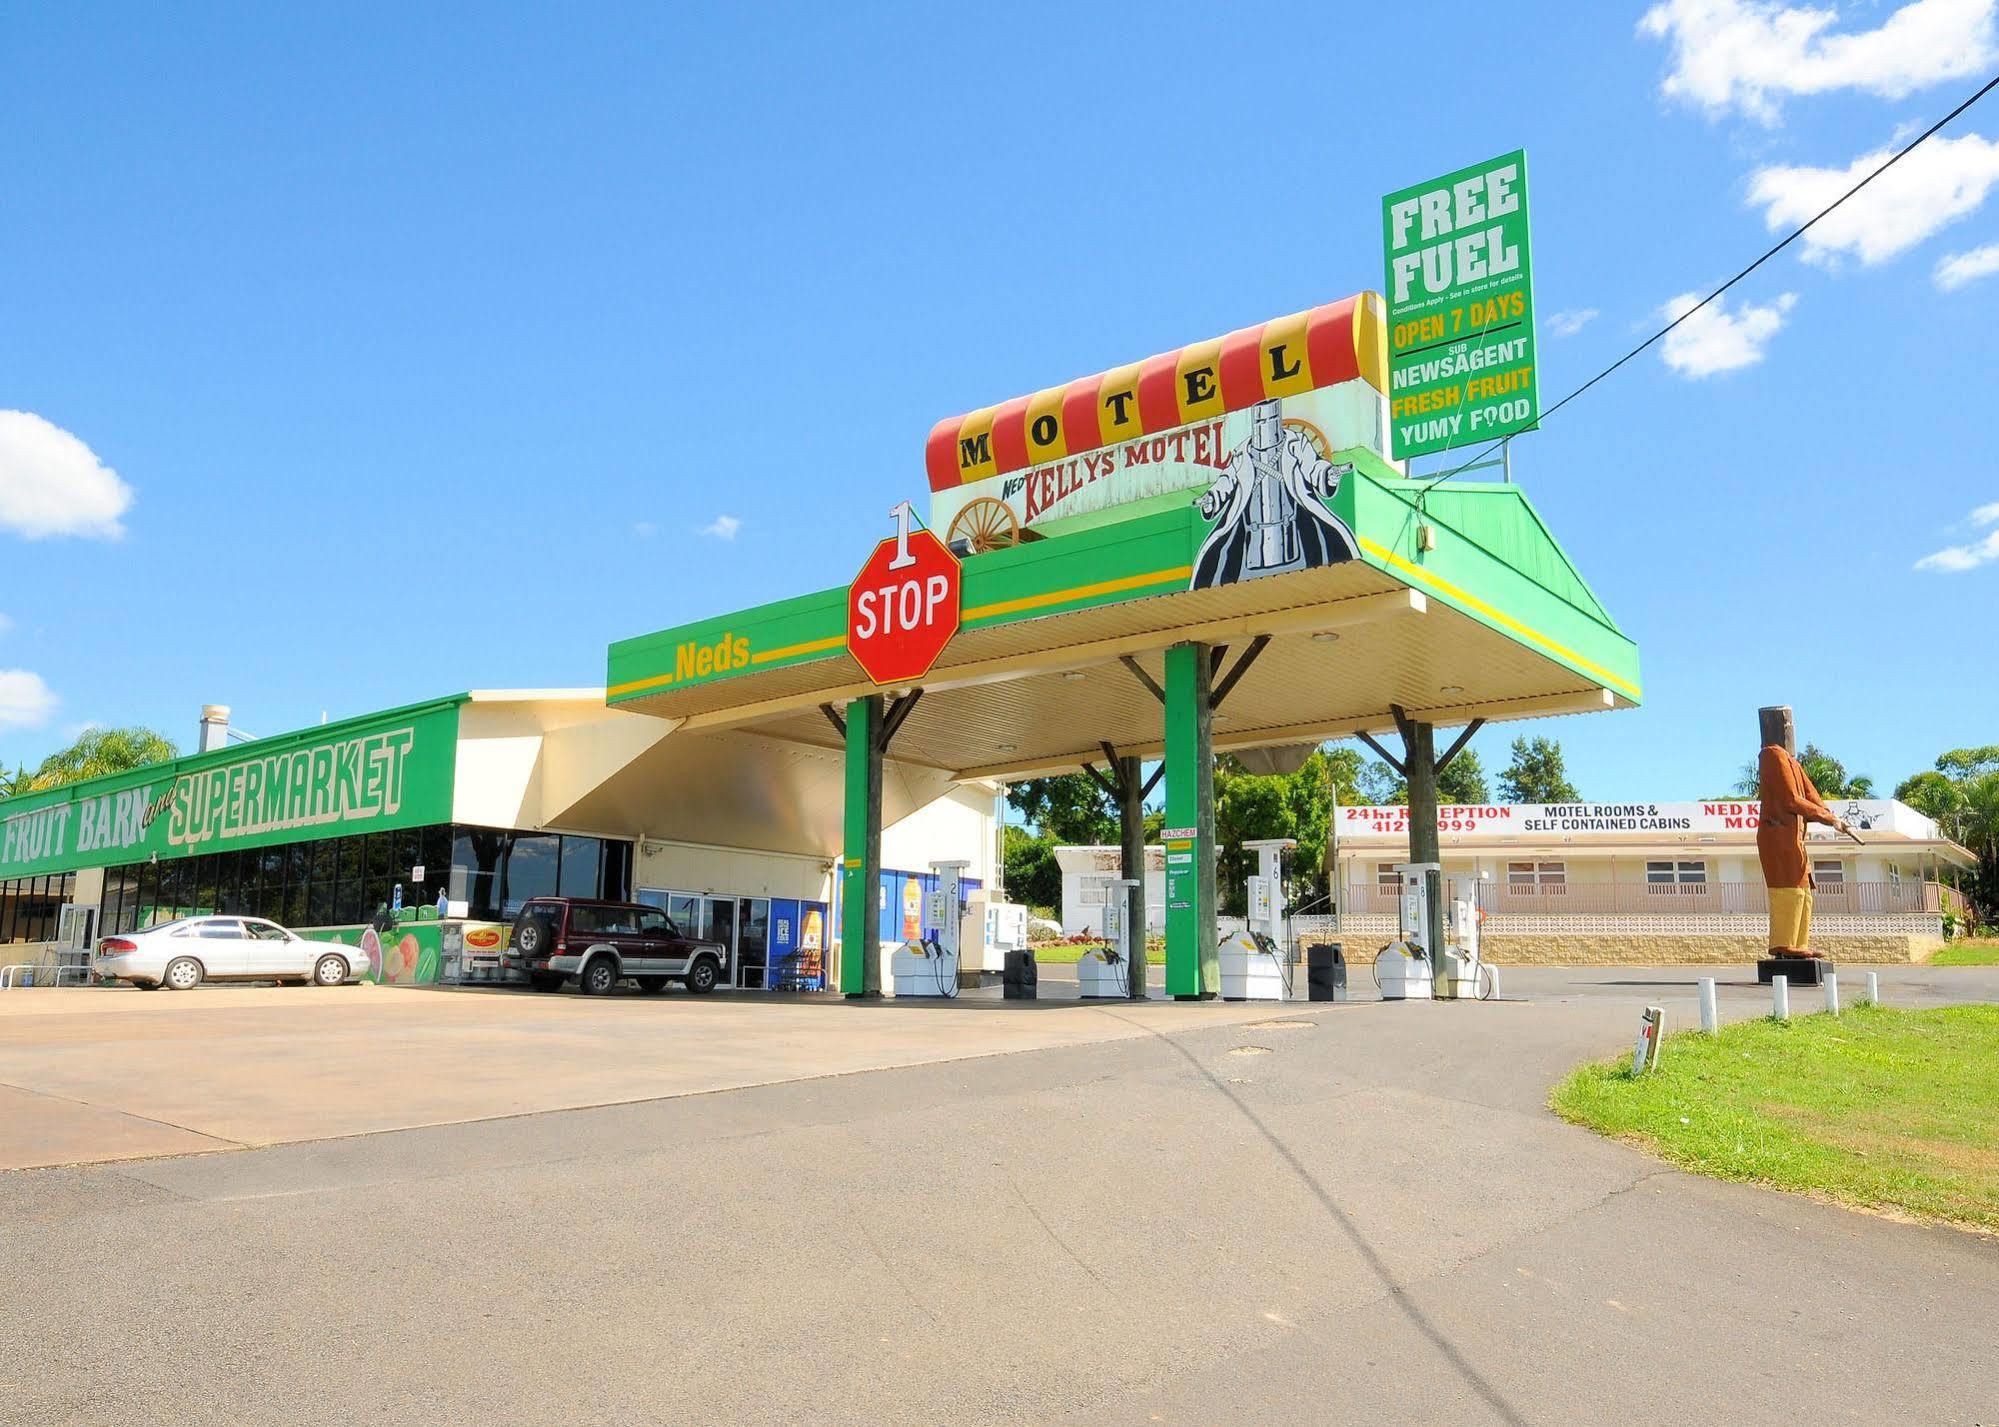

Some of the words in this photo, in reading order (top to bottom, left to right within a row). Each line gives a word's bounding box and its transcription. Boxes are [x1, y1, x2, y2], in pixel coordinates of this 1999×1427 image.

[1391, 163, 1519, 250] FREE
[1392, 225, 1519, 304] FUEL
[1392, 302, 1425, 316] Conditions
[1426, 296, 1444, 307] Apply
[1450, 291, 1462, 300] See
[1471, 284, 1488, 294] store
[1500, 273, 1524, 285] details
[1393, 313, 1444, 349] OPEN
[1451, 308, 1463, 333] 7
[1470, 291, 1525, 328] DAYS
[1392, 337, 1527, 390] NEWSAGENT
[1448, 343, 1467, 356] SUB
[960, 344, 1301, 468] MOTEL
[1391, 384, 1461, 420] FRESH
[1467, 367, 1533, 402] FRUIT
[1400, 413, 1463, 446] YUMY
[1470, 398, 1530, 431] FOOD
[1002, 476, 1026, 501] NED
[1025, 450, 1115, 525] KELLYS
[1125, 421, 1233, 471] MOTEL
[888, 500, 916, 570] 1
[856, 574, 949, 639] STOP
[676, 632, 750, 682] Neds
[2, 805, 71, 863] FRUIT
[76, 785, 152, 852] BARN
[142, 775, 180, 829] and
[168, 727, 414, 848] SUPERMARKET
[1399, 807, 1511, 819] REPTION
[1544, 806, 1592, 817] MOTEL
[1594, 805, 1644, 817] ROOMS
[1647, 804, 1658, 816] &
[1704, 803, 1743, 816] NED
[1161, 829, 1196, 838] HAZCHEM
[1524, 819, 1557, 831] SELF
[1561, 818, 1636, 830] CONTAINED
[1639, 818, 1690, 829] CABINS
[950, 883, 957, 894] 2
[1273, 867, 1278, 879] 6
[1420, 886, 1425, 897] 8
[1122, 899, 1127, 909] 4
